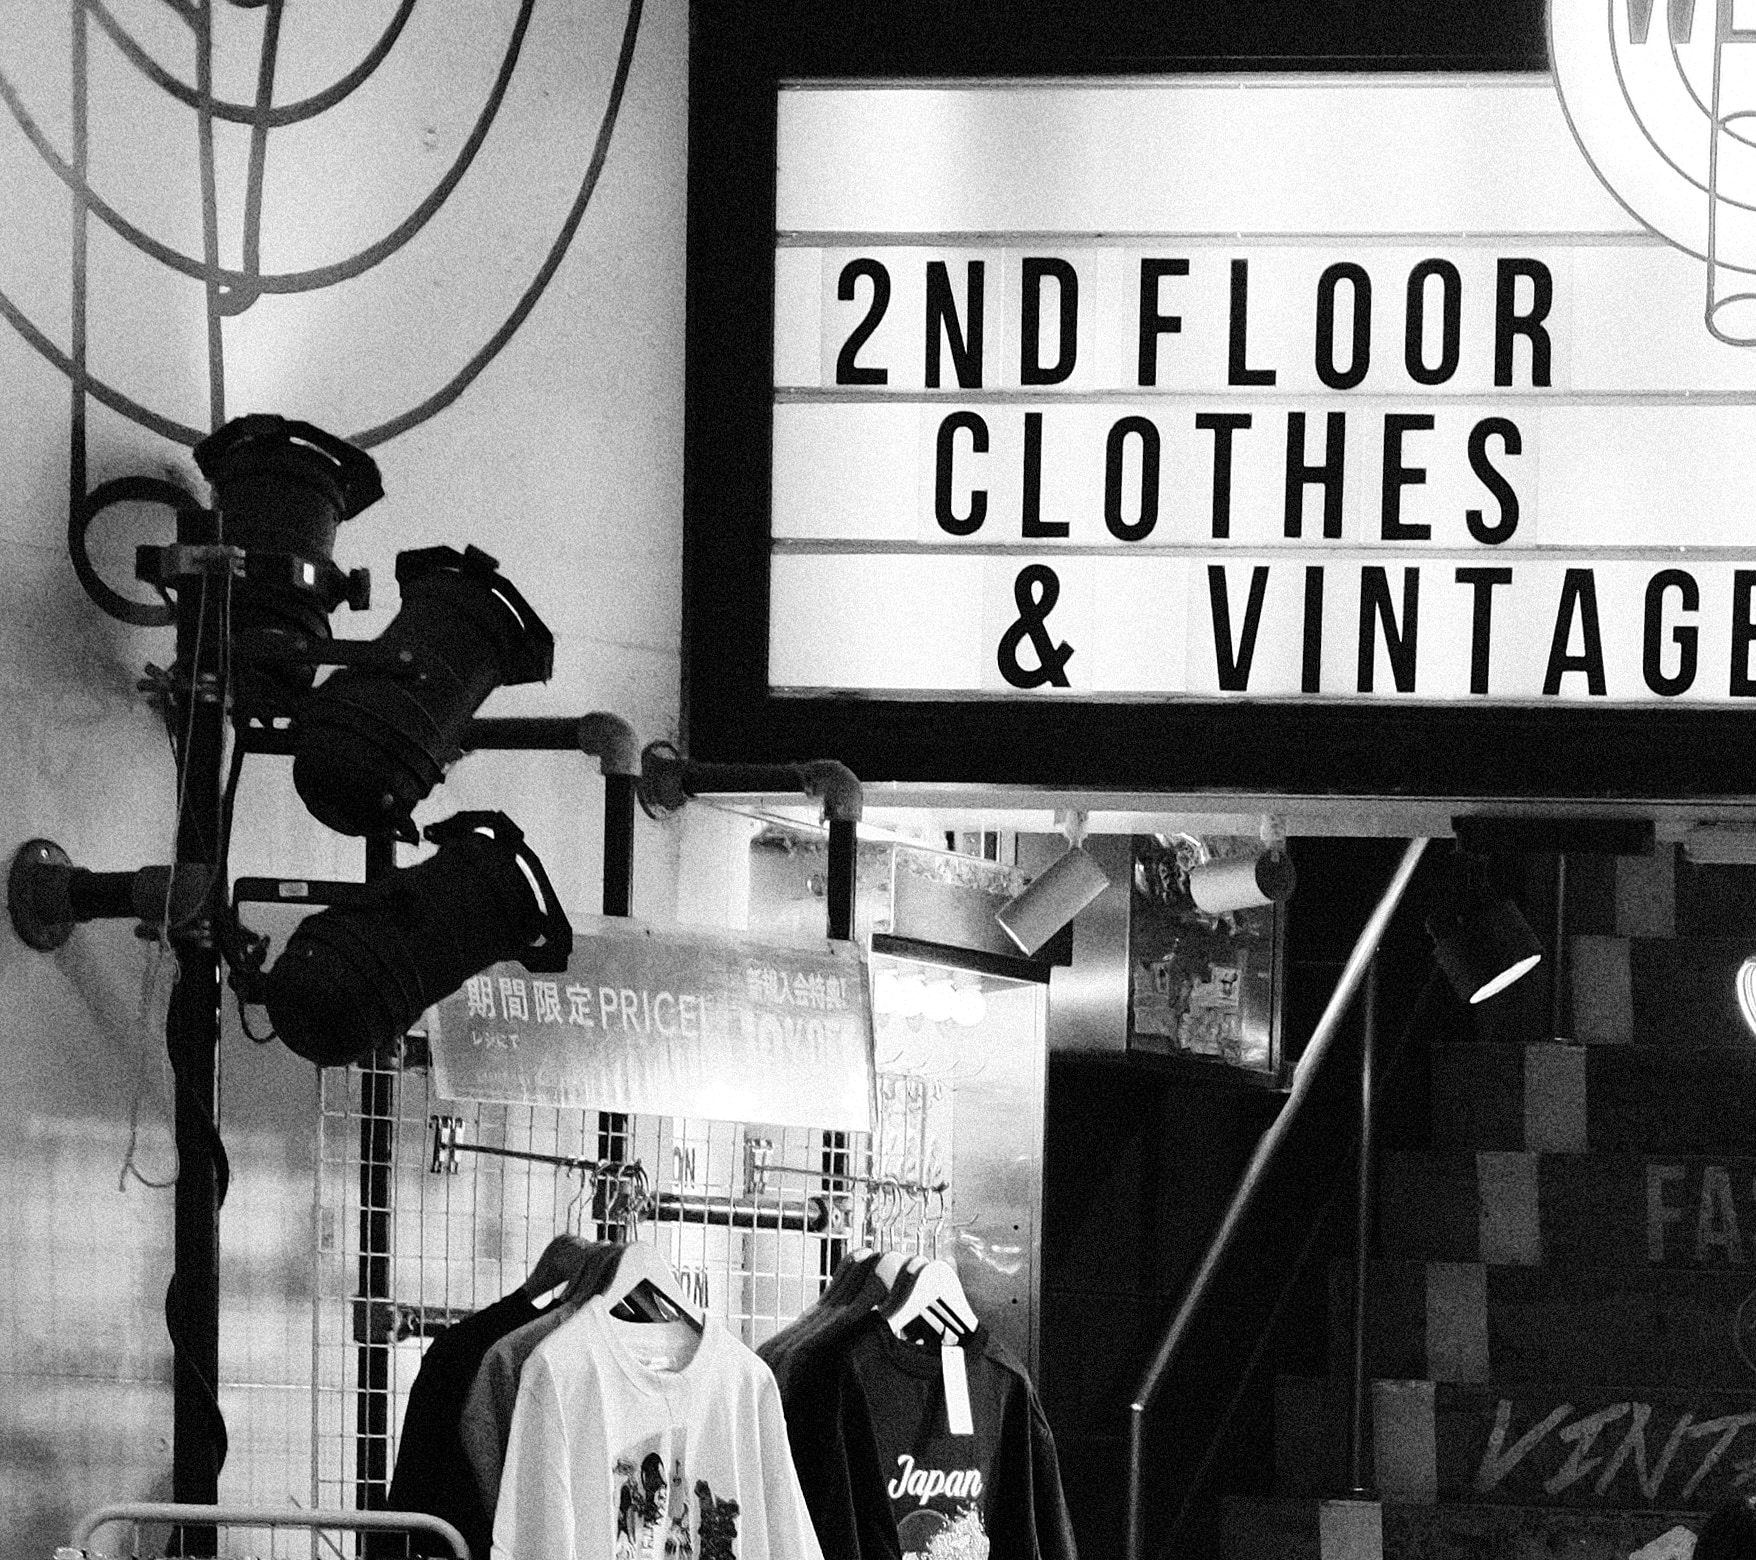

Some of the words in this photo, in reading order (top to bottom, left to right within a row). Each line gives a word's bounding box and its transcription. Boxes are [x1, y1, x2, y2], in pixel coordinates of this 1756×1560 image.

[836, 257, 1078, 389] 2ND
[1138, 257, 1553, 390] FLOOR
[935, 411, 1522, 545] CLOTHES
[997, 564, 1075, 689] &
[888, 1453, 984, 1505] Japan
